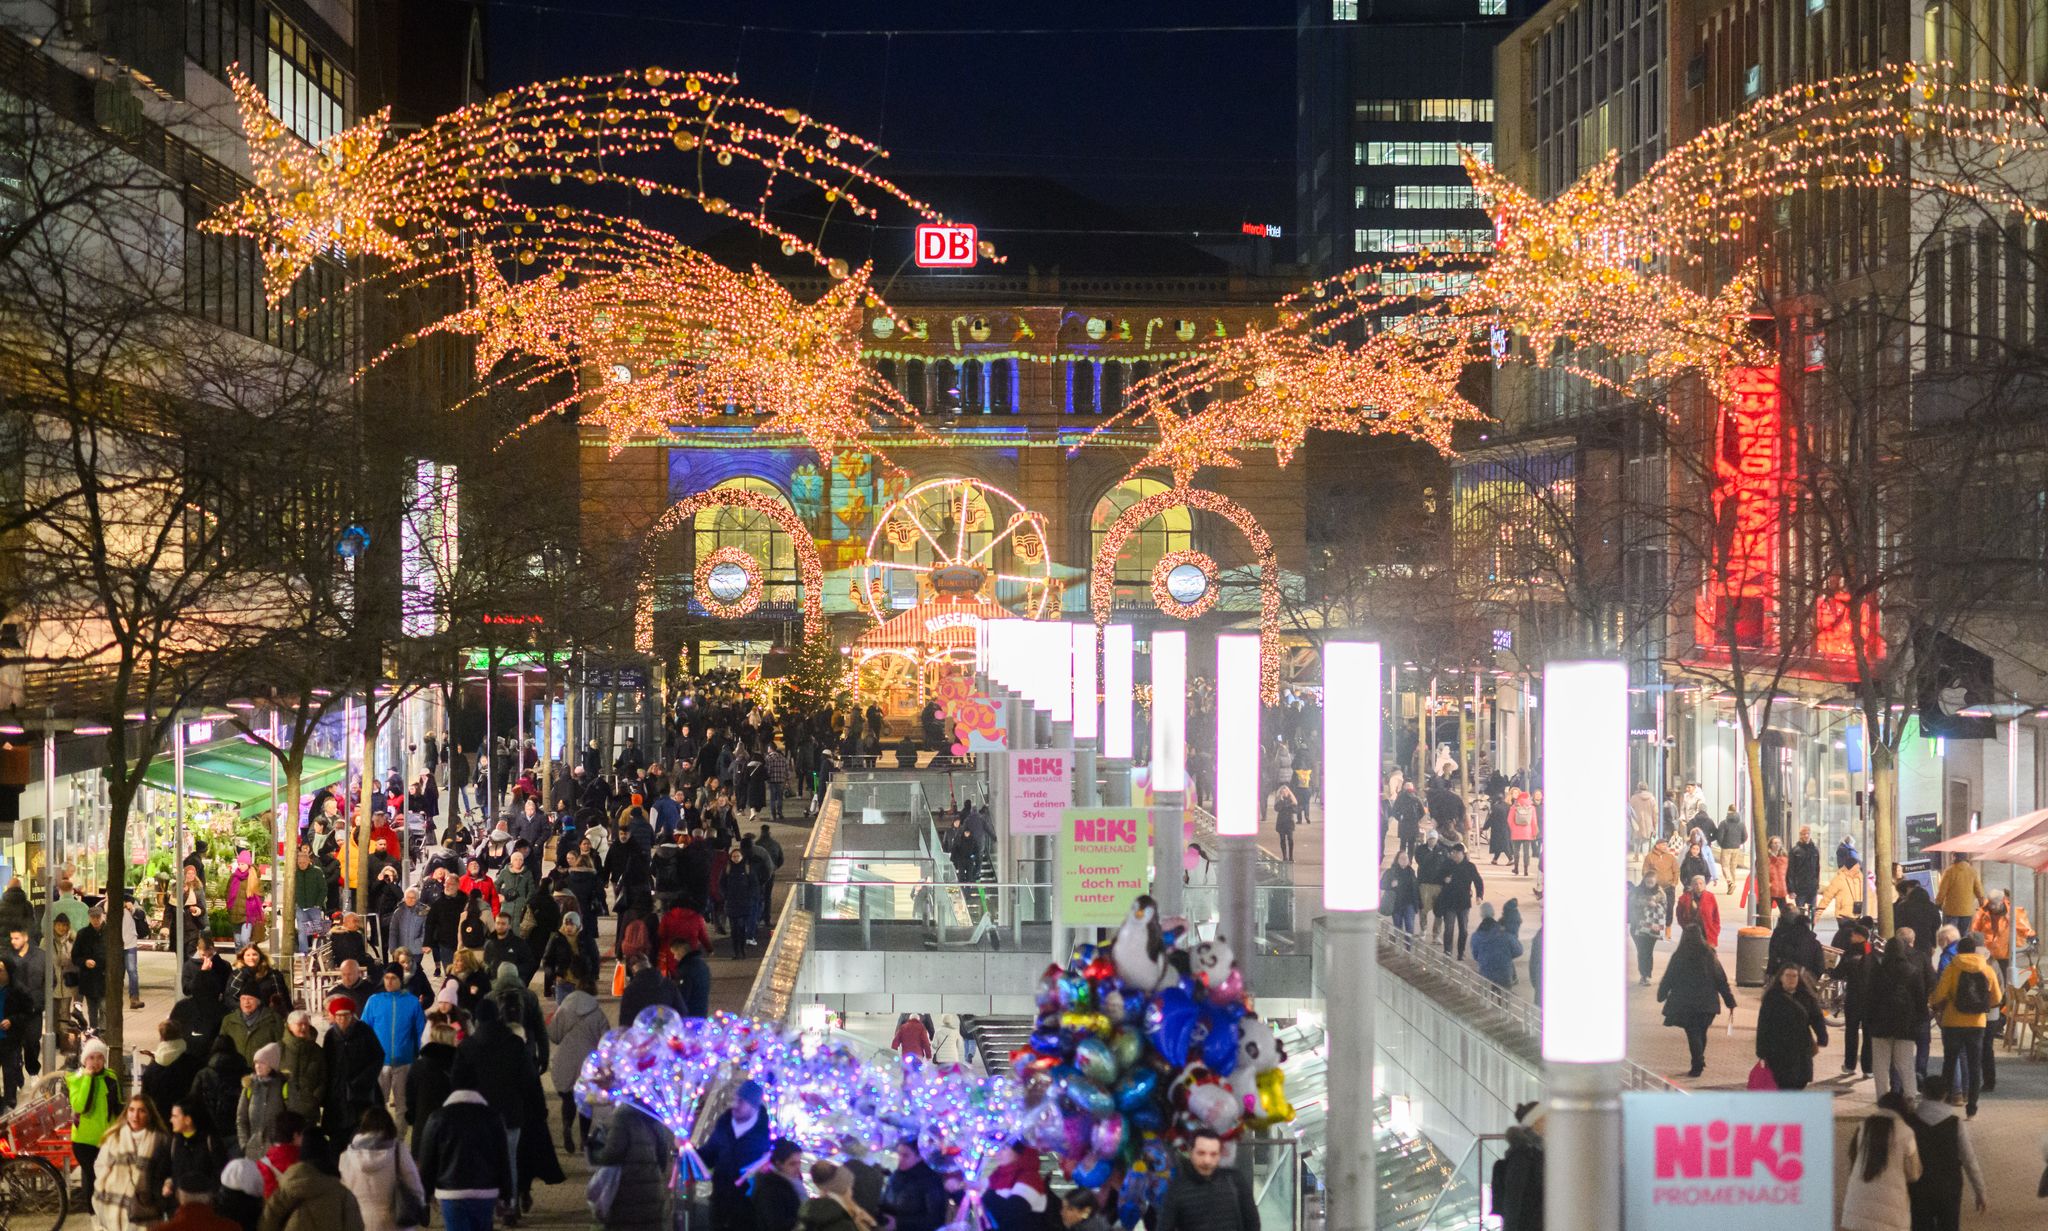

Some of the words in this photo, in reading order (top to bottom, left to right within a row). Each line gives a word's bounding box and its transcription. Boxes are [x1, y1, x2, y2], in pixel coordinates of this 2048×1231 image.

[924, 231, 970, 260] DB
[925, 613, 981, 632] RIESENR
[1033, 800, 1066, 808] deinen
[1022, 810, 1046, 820] Style
[1074, 845, 1137, 853] PROMENADE
[1081, 878, 1114, 889] doch
[1117, 878, 1142, 889] mal
[1074, 894, 1115, 903] runter
[1653, 1185, 1803, 1206] PROMENADE
